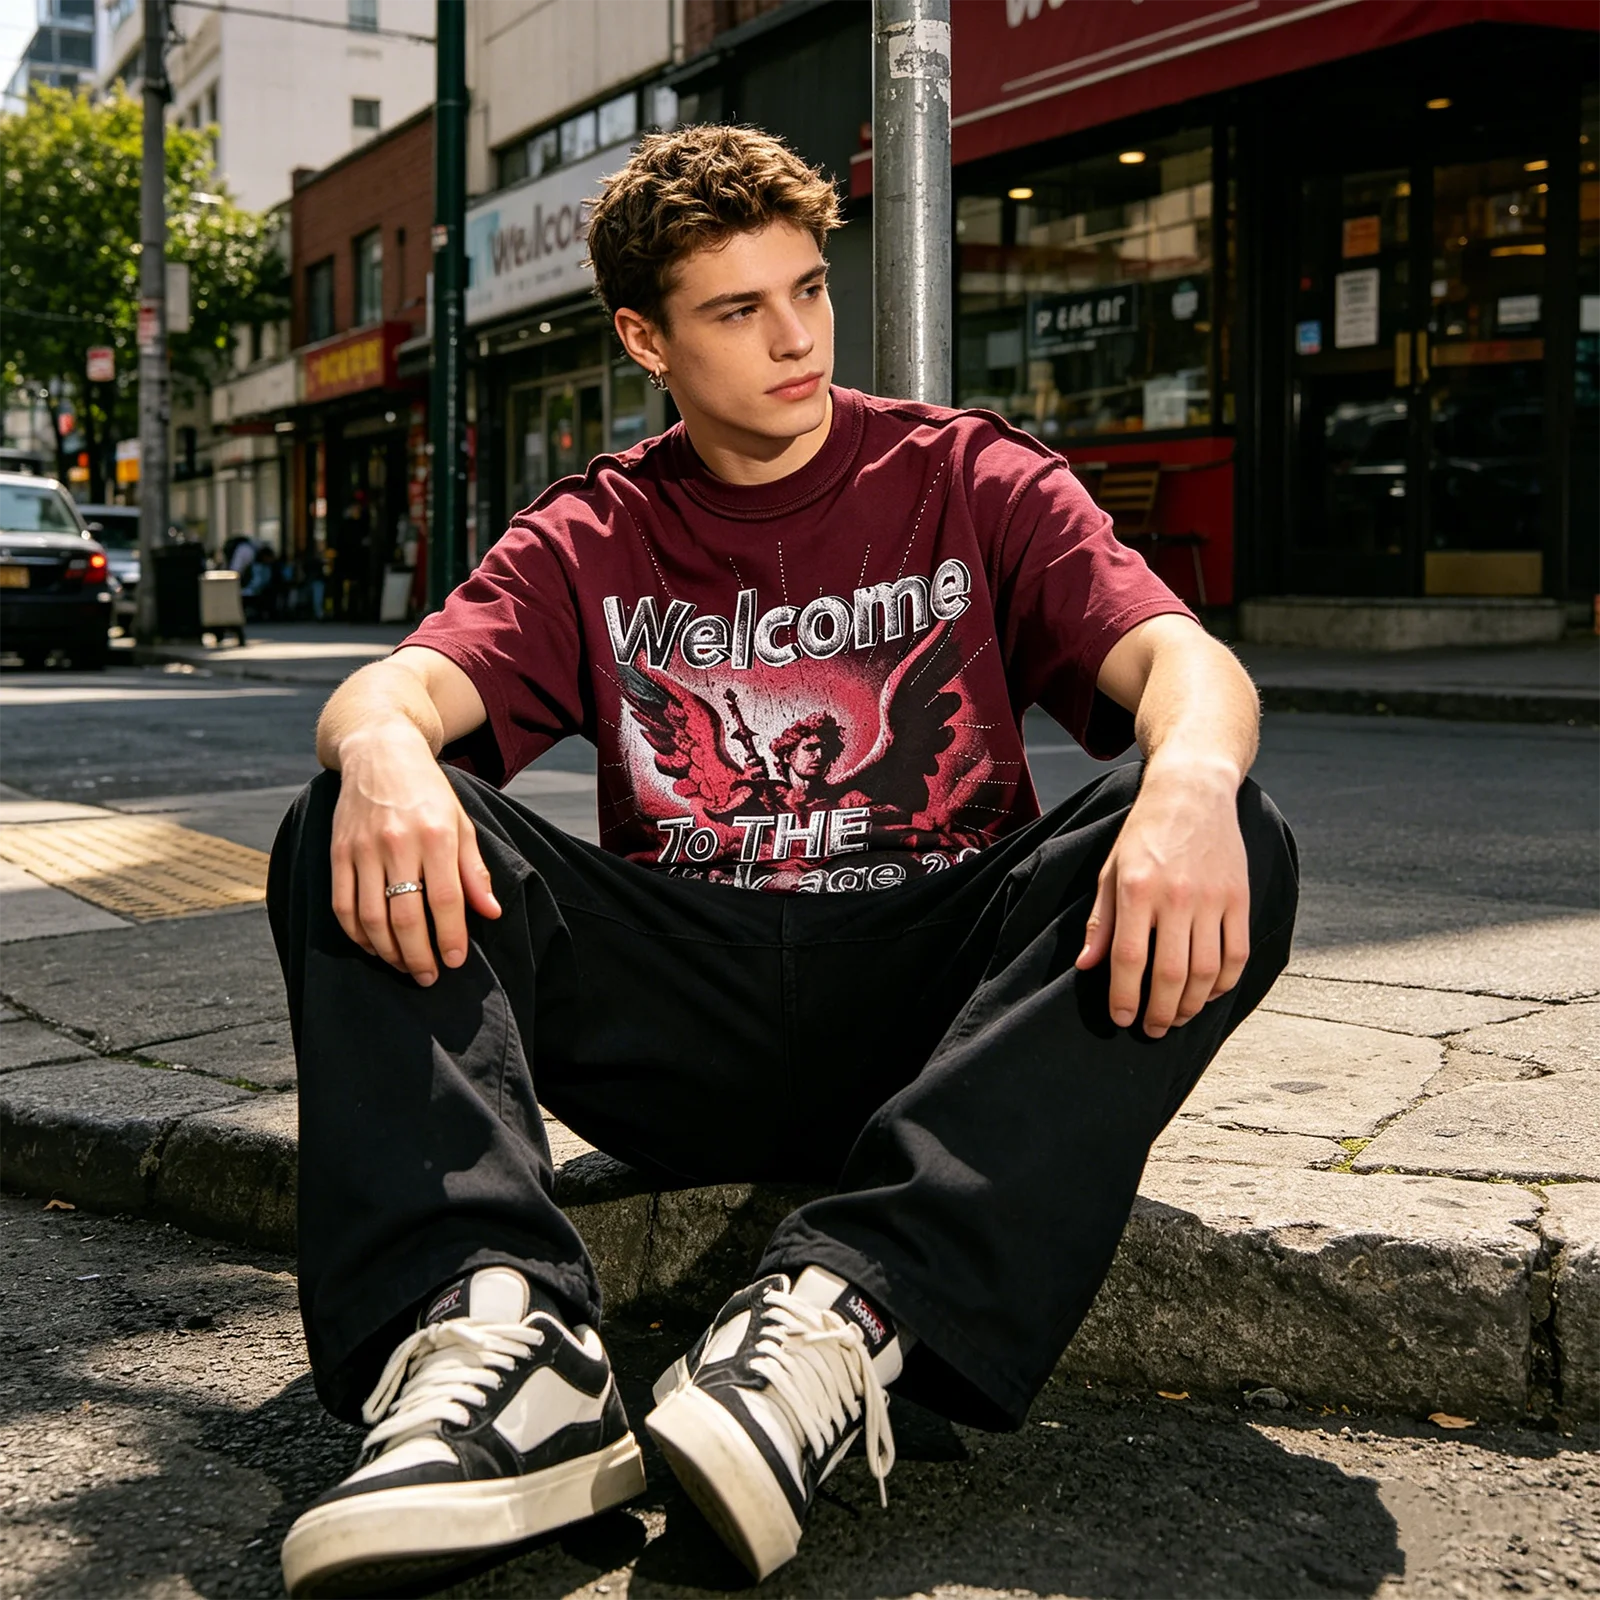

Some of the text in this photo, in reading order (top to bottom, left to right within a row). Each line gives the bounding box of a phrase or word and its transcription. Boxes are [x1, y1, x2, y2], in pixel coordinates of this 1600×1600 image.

[603, 558, 971, 670] Welcome
[657, 807, 872, 863] To THE
